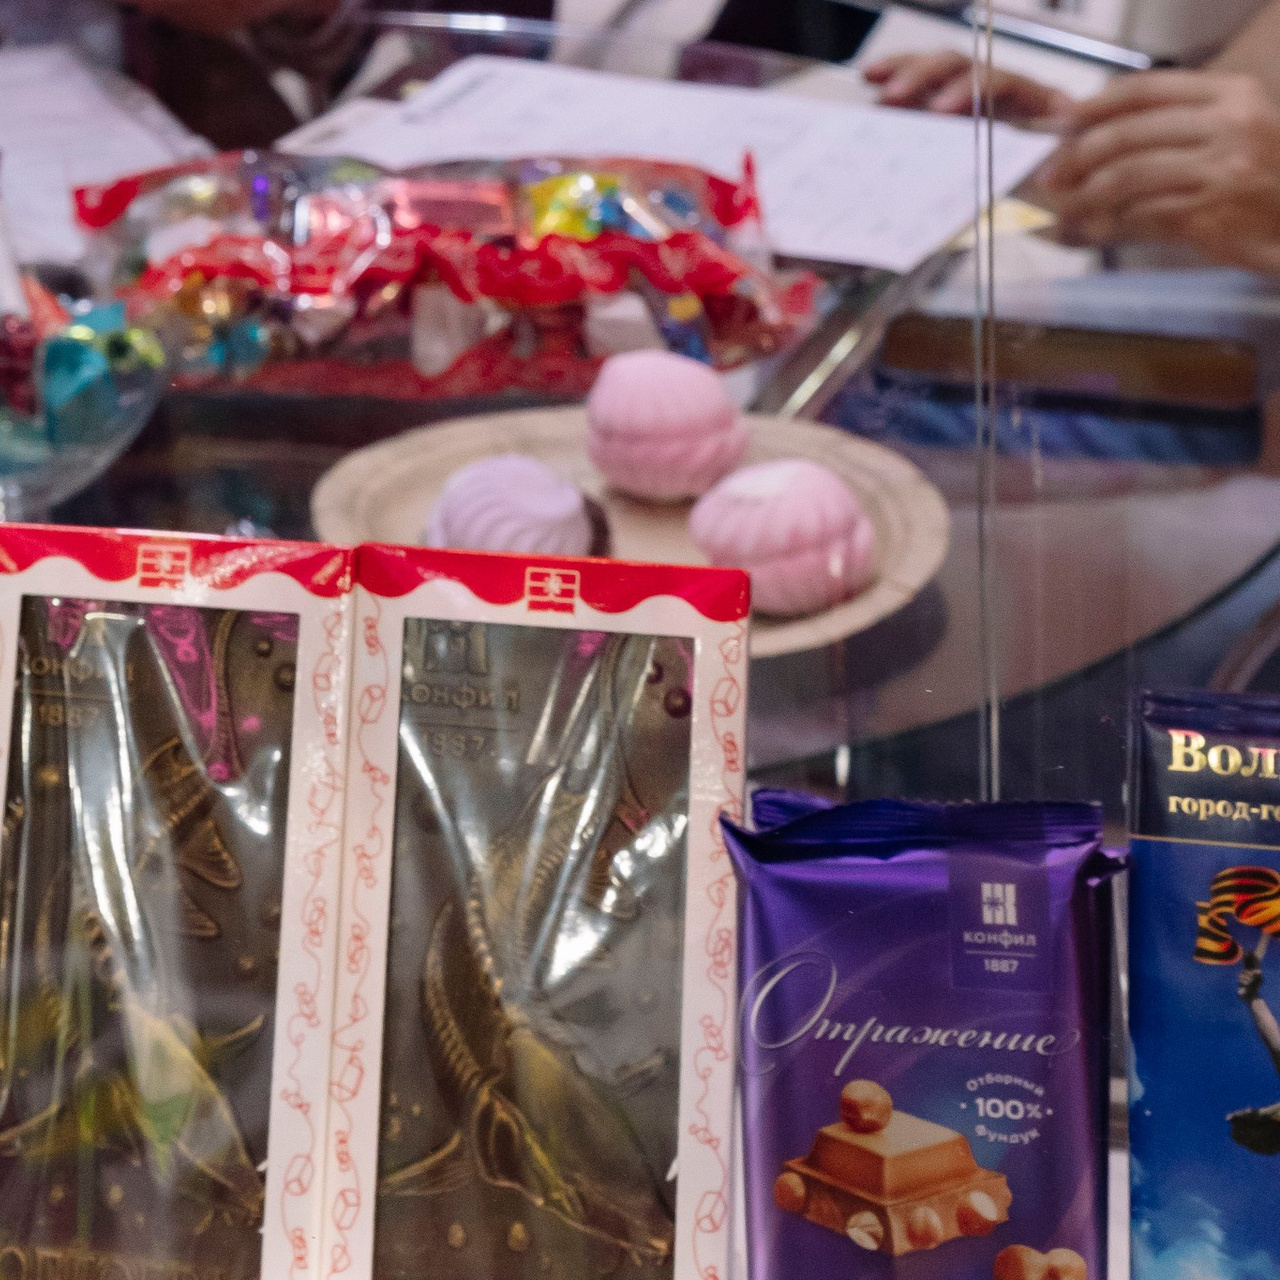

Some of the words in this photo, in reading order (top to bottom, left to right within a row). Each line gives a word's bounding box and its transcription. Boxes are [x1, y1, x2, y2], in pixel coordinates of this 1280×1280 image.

[1166, 728, 1280, 779] Вол
[963, 929, 1038, 949] конфил
[984, 959, 1019, 974] 1887
[742, 951, 1065, 1077] Отражение
[974, 1096, 1043, 1120] 100%
